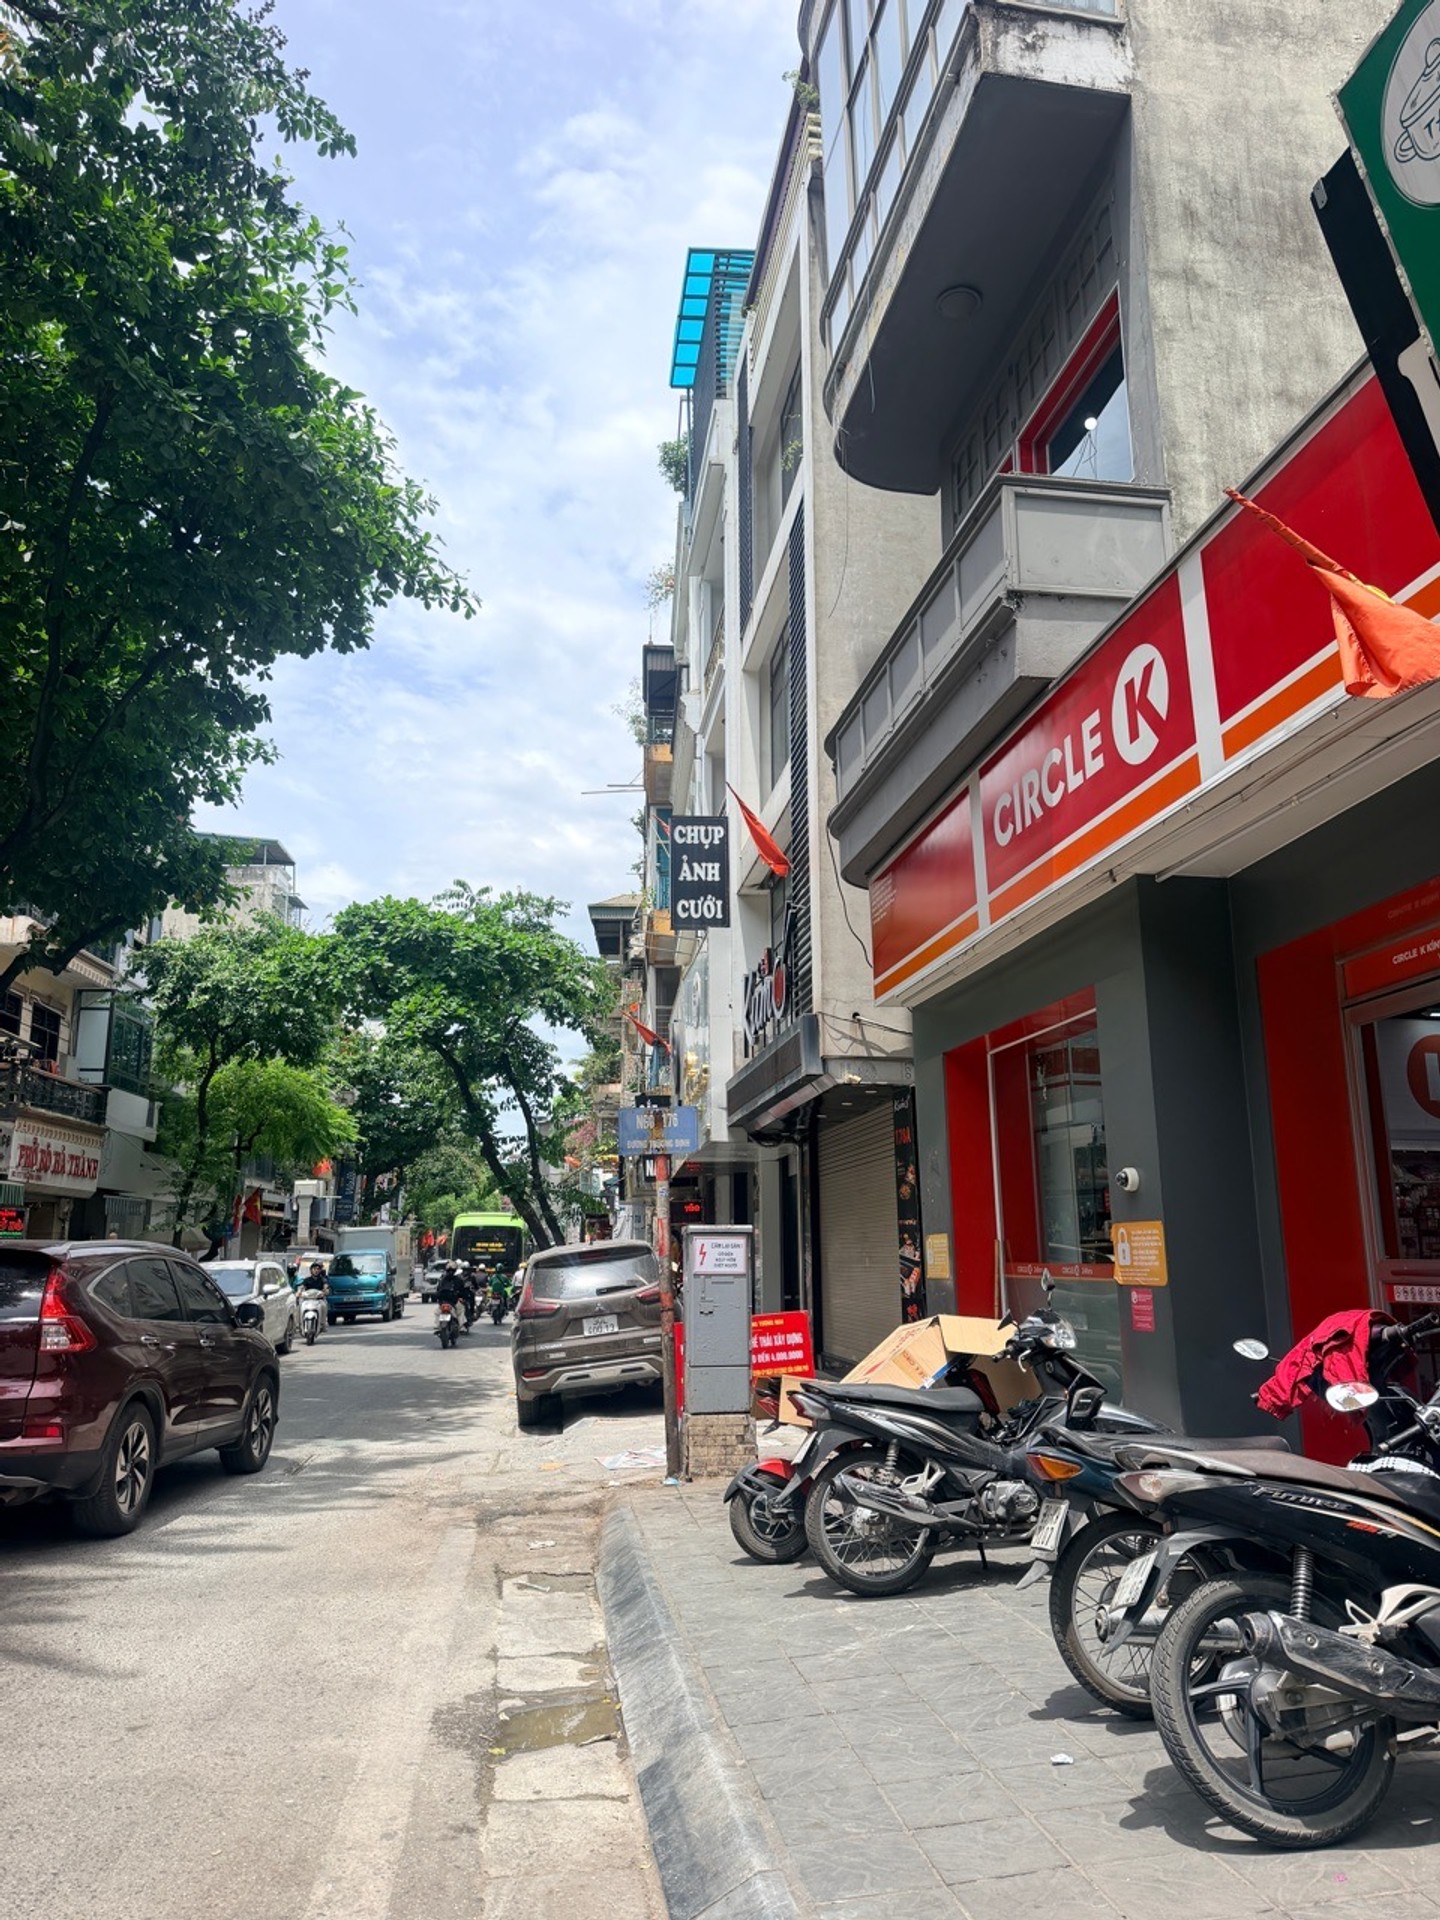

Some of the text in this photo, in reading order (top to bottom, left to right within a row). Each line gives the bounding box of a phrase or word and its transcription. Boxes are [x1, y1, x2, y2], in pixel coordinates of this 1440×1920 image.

[994, 645, 1169, 847] CIRCLE K
[673, 824, 725, 849] CHỤP
[678, 854, 720, 881] ẢNH
[676, 894, 723, 919] CƯỚI
[1392, 948, 1418, 964] CIRCLE
[662, 1112, 679, 1128] 176
